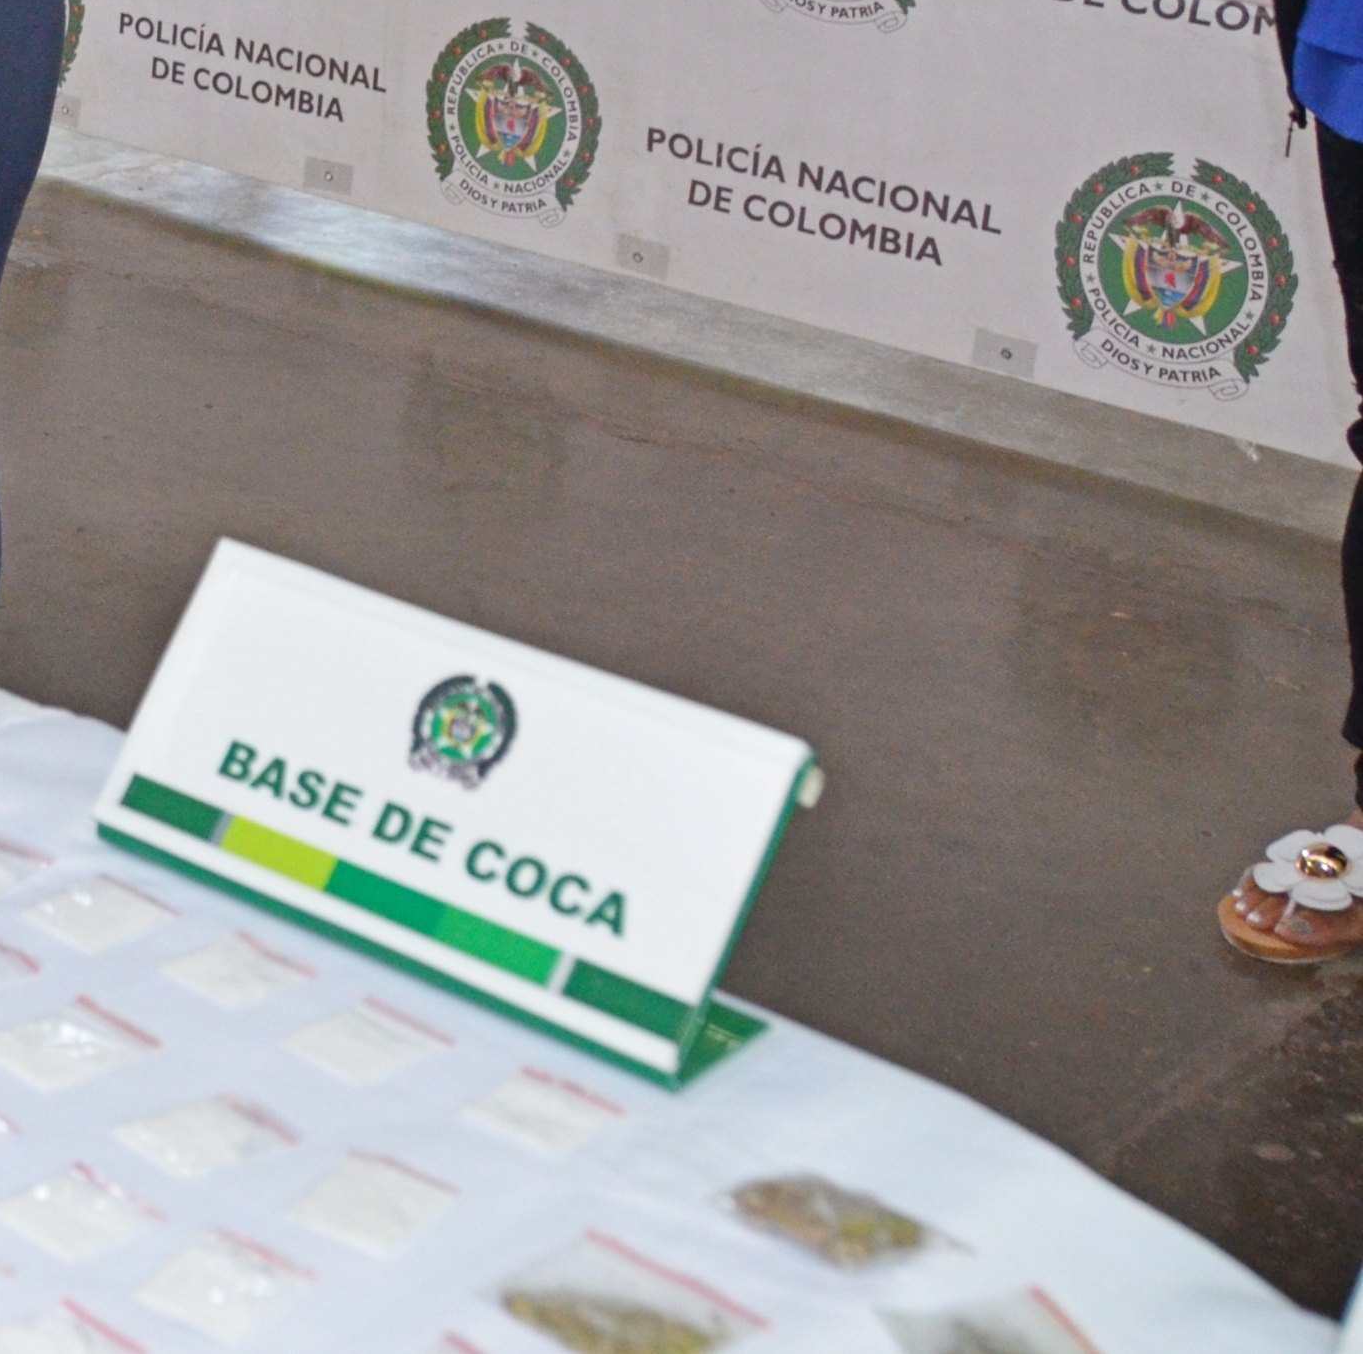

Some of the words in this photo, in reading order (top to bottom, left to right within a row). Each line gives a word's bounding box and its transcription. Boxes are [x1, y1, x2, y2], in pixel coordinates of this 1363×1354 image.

[818, 3, 826, 15] Y
[831, 1, 885, 19] PATRIA
[120, 13, 225, 56] POLICÍA
[235, 38, 386, 93] NACIONAL
[152, 57, 185, 84] DE
[194, 68, 343, 122] COLOMBIA
[447, 43, 496, 115] REPUBLICA
[510, 40, 528, 55] DE
[543, 56, 578, 143] COLOMBIA
[459, 179, 488, 206] DIOS
[490, 197, 498, 208] Y
[501, 198, 547, 213] PATRIA
[504, 160, 567, 194] NACIONAL
[647, 128, 785, 183] POLICÍA
[798, 162, 1001, 234] NACIONAL
[688, 180, 733, 213] DE
[744, 195, 942, 266] COLOMBIA
[1083, 182, 1151, 264] REPUBLICA
[1171, 180, 1196, 198] DE
[1217, 201, 1265, 304] COLOMBIA
[1101, 339, 1140, 372] DIOS
[1143, 363, 1153, 375] Y
[1159, 366, 1222, 382] PATRIA
[1162, 323, 1249, 360] NACIONAL
[218, 741, 362, 825] BASE
[372, 802, 451, 862] DE
[465, 842, 625, 936] COCA
